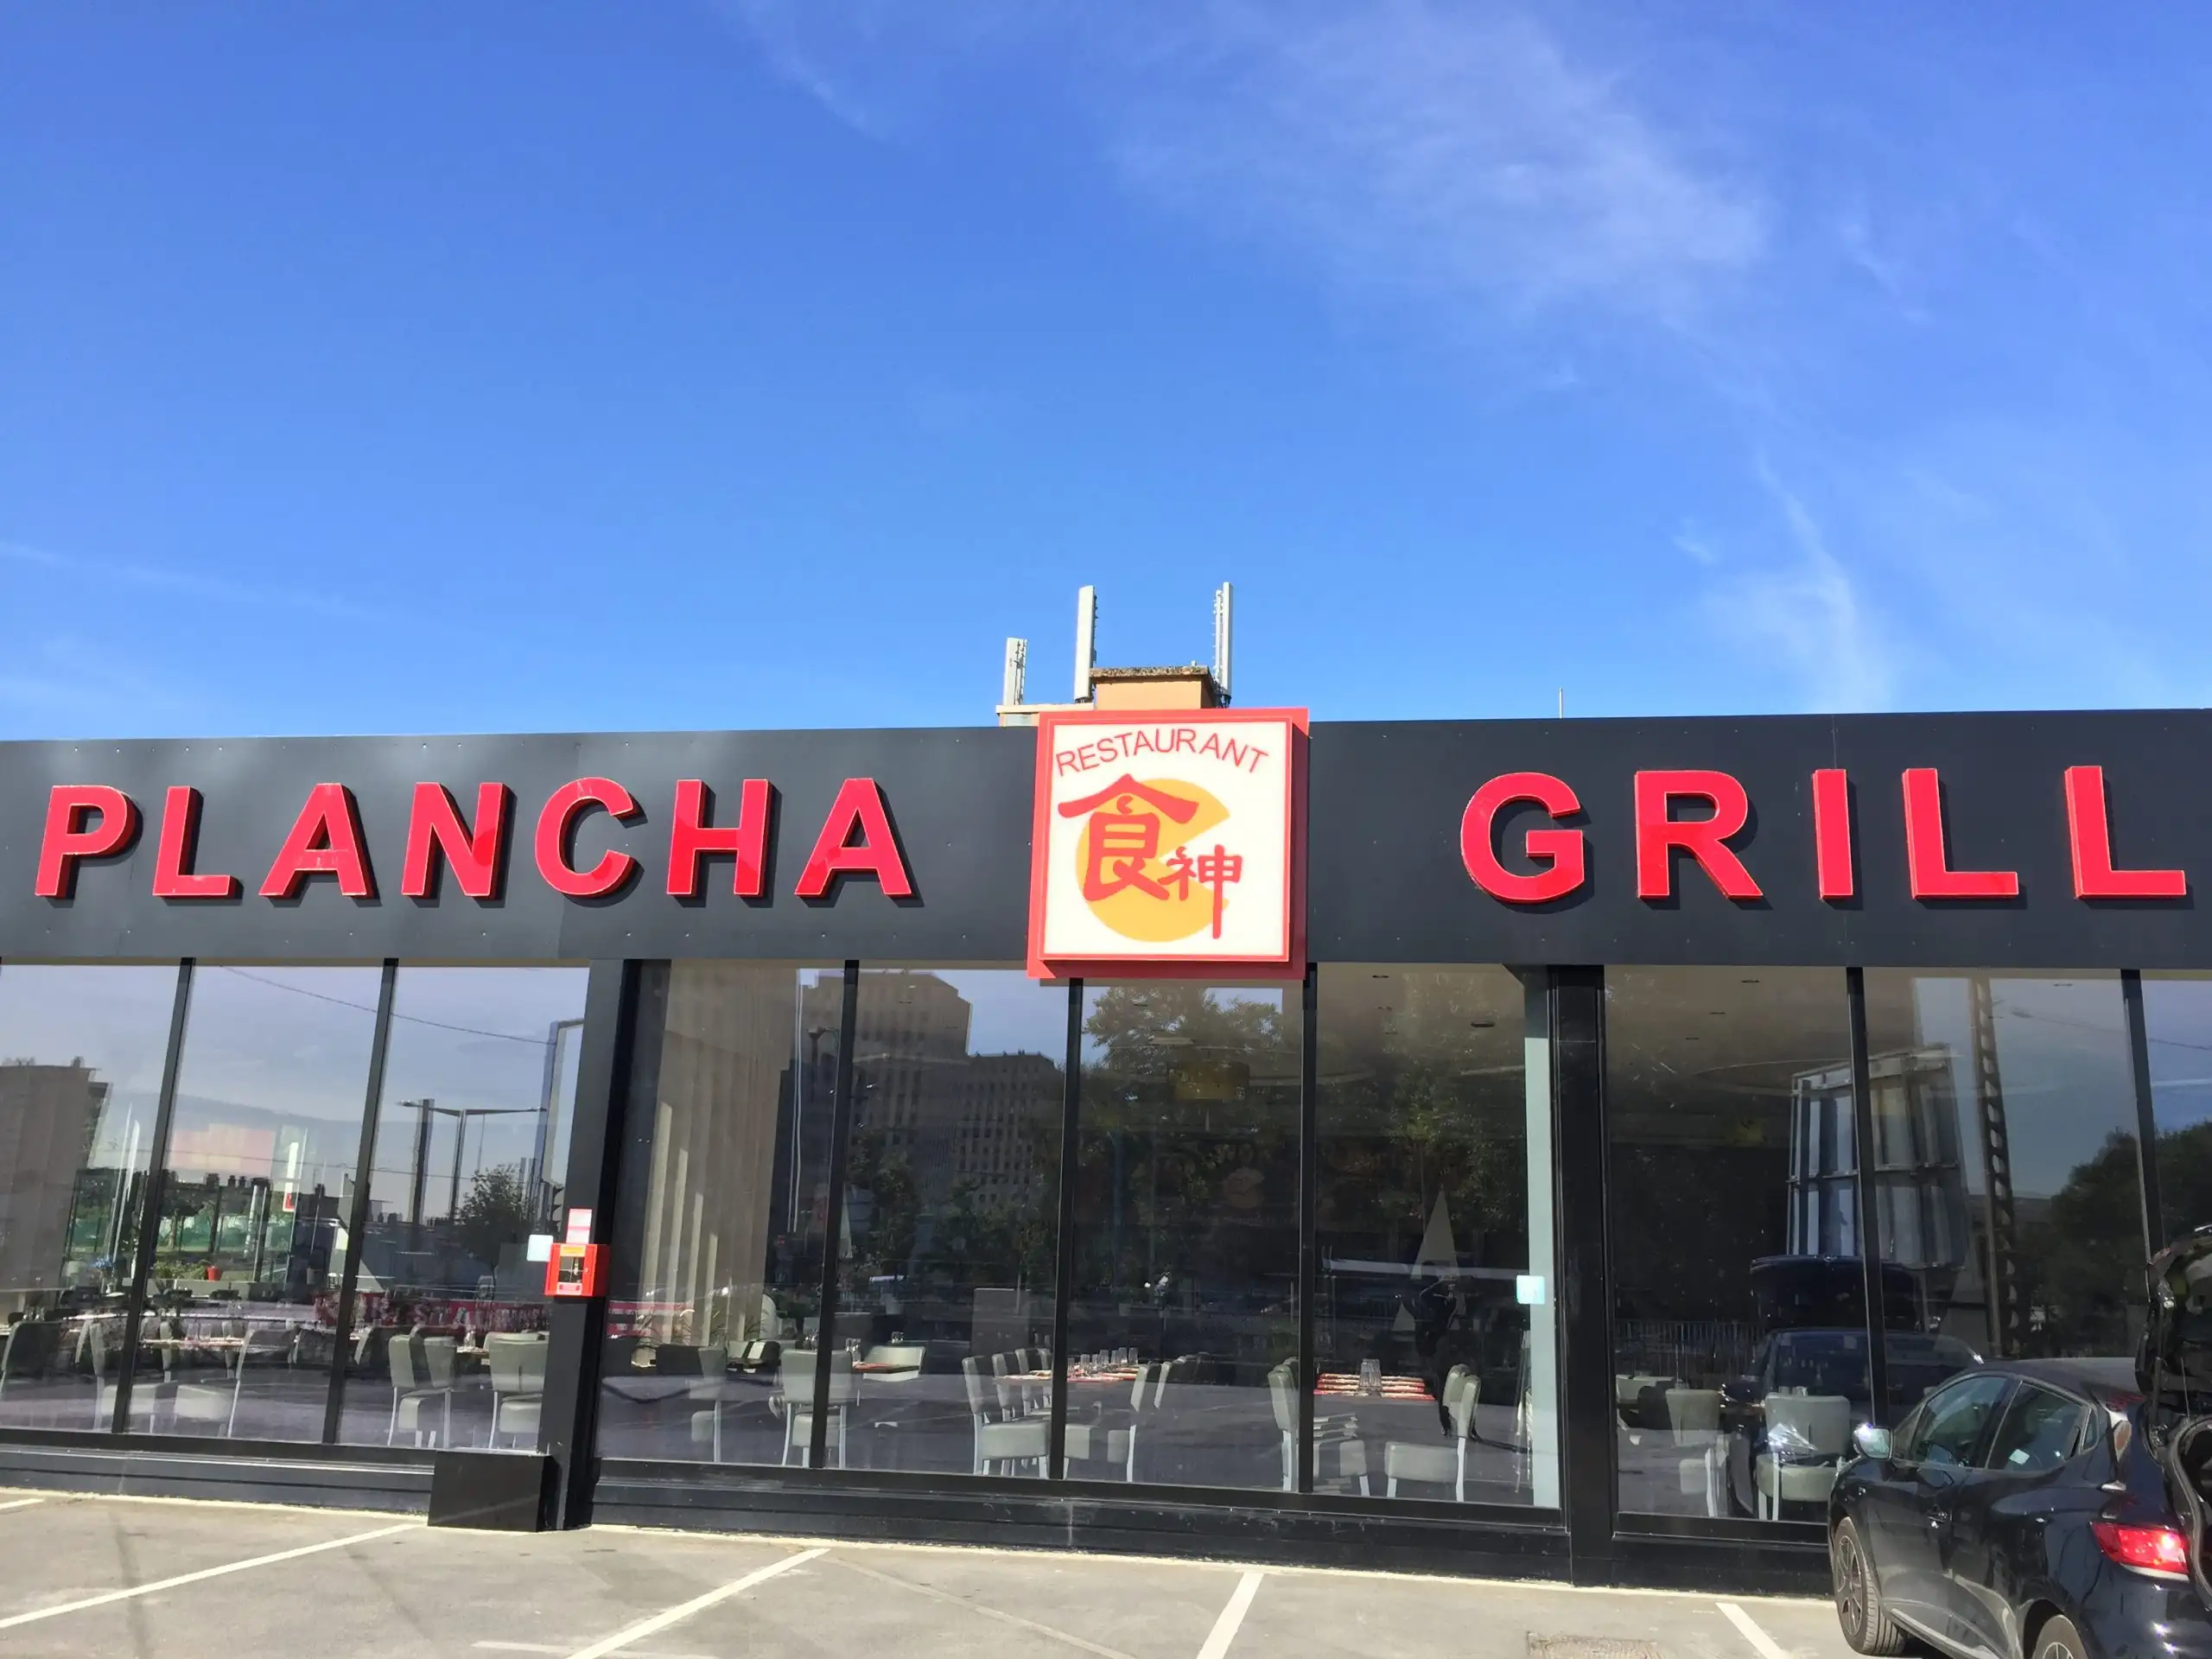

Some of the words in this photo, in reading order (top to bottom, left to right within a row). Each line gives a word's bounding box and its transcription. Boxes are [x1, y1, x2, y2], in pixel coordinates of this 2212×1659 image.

[1055, 728, 1269, 777] RESTAURANT
[35, 777, 912, 899] PLANCHA
[1460, 765, 2189, 901] GRILL
[1058, 773, 1243, 939] 食神
